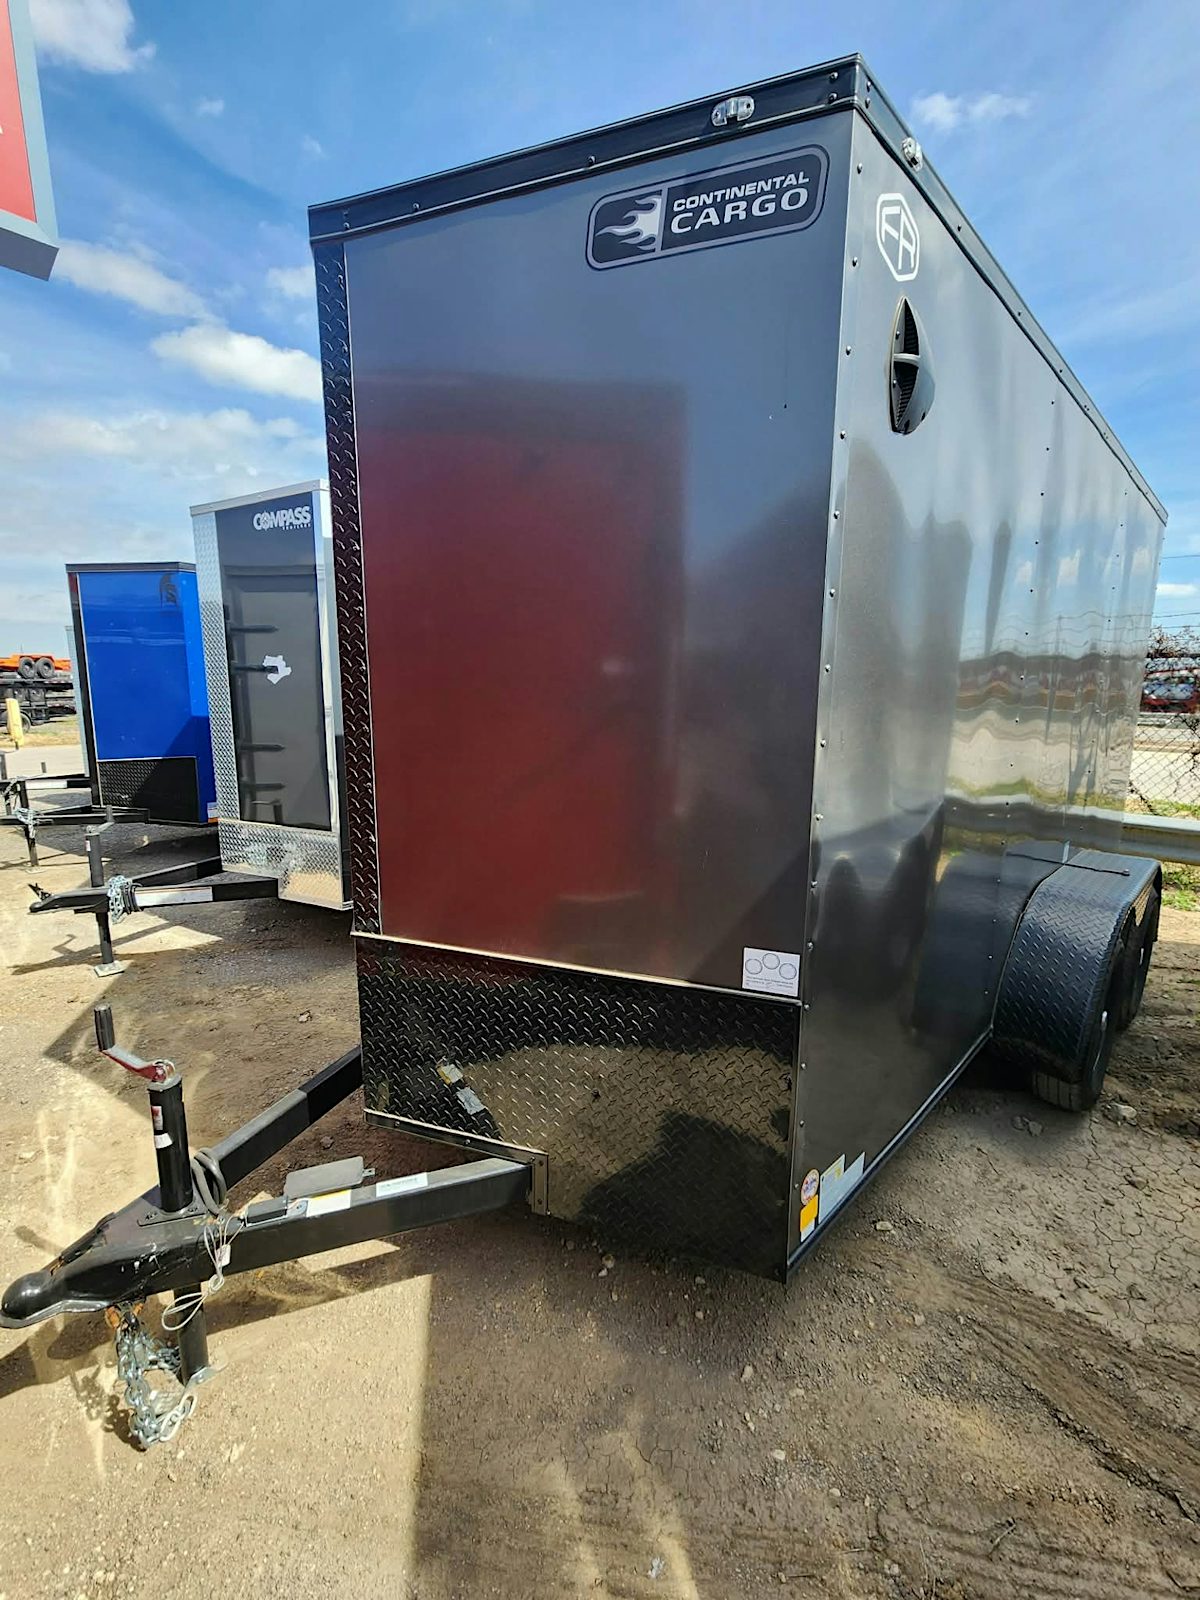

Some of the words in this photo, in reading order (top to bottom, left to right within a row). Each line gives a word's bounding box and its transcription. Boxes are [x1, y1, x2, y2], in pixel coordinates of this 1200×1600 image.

[670, 187, 808, 234] CARGO
[673, 171, 810, 212] CONTINENTAL
[253, 505, 311, 531] COMPASS
